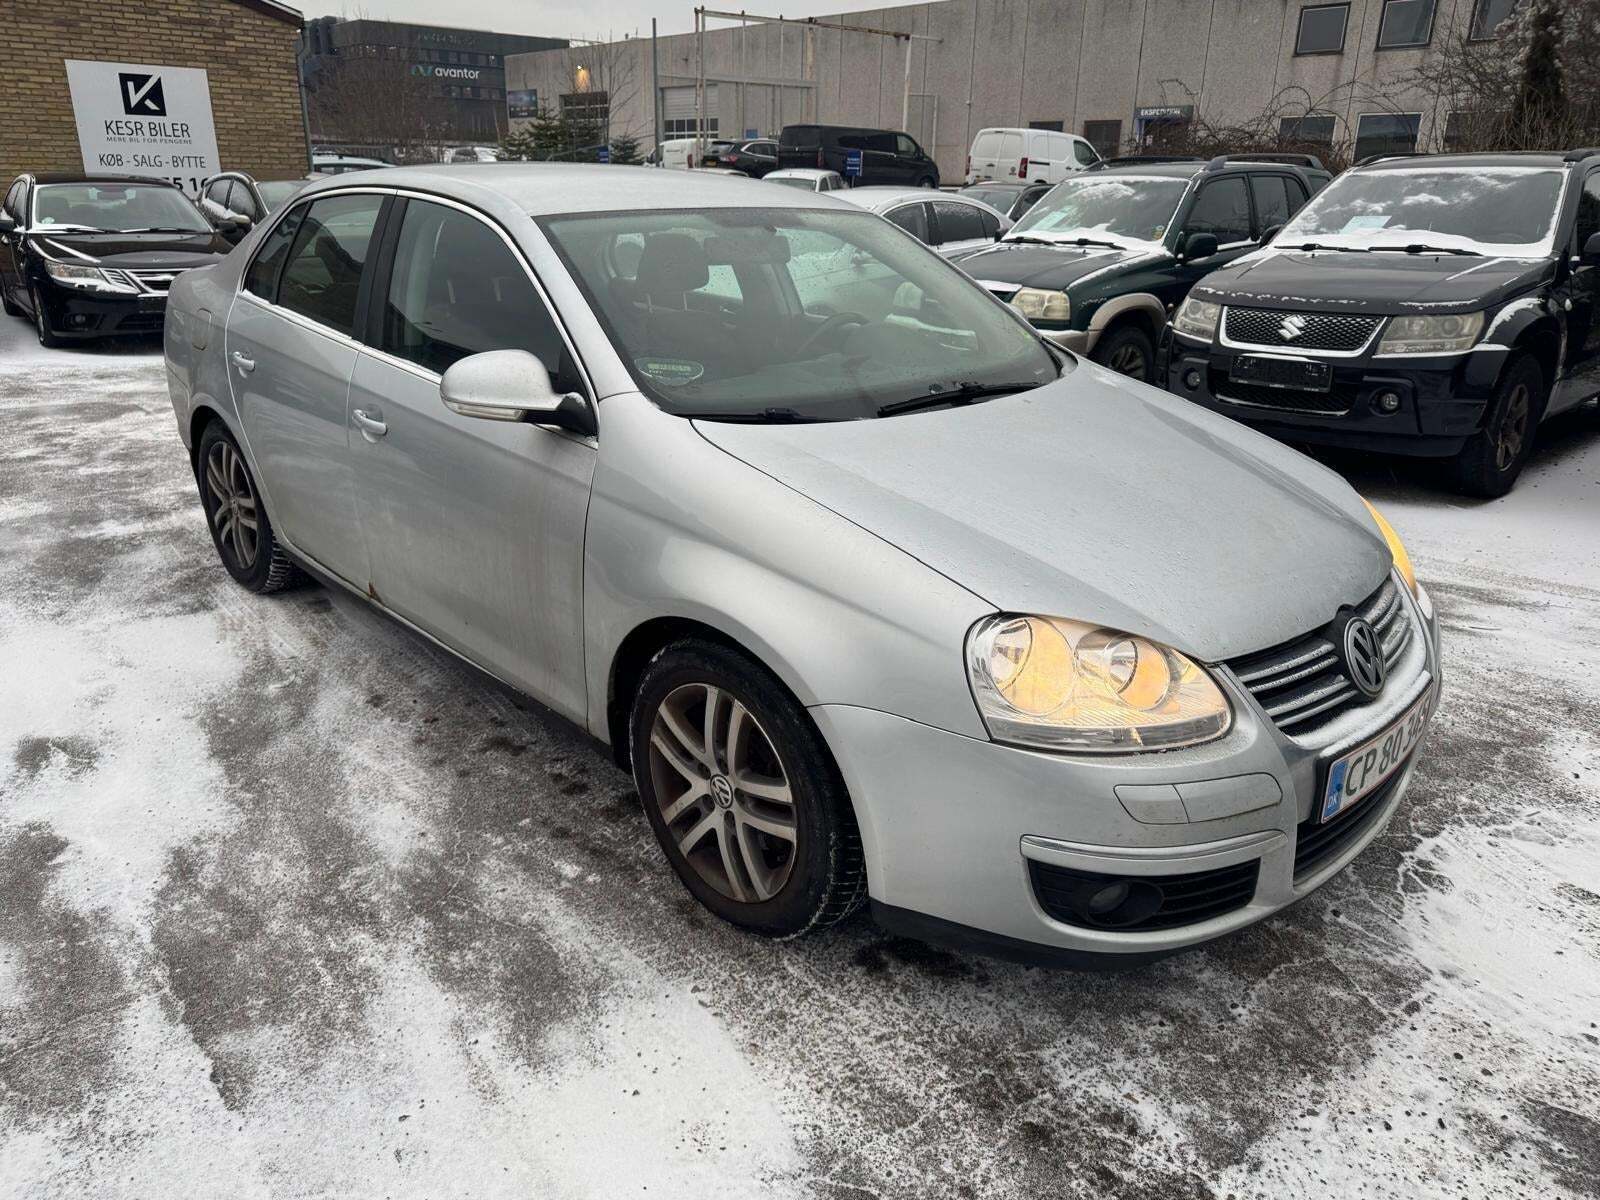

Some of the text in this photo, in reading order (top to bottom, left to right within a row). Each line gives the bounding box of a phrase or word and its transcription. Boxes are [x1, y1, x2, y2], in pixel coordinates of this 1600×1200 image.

[435, 67, 480, 79] avantor
[104, 120, 191, 137] KESR BILER
[99, 153, 123, 167] KØB
[133, 154, 162, 167] SALG
[172, 155, 206, 168] BYTTE
[1345, 747, 1378, 797] CP
[1378, 726, 1404, 775] 80
